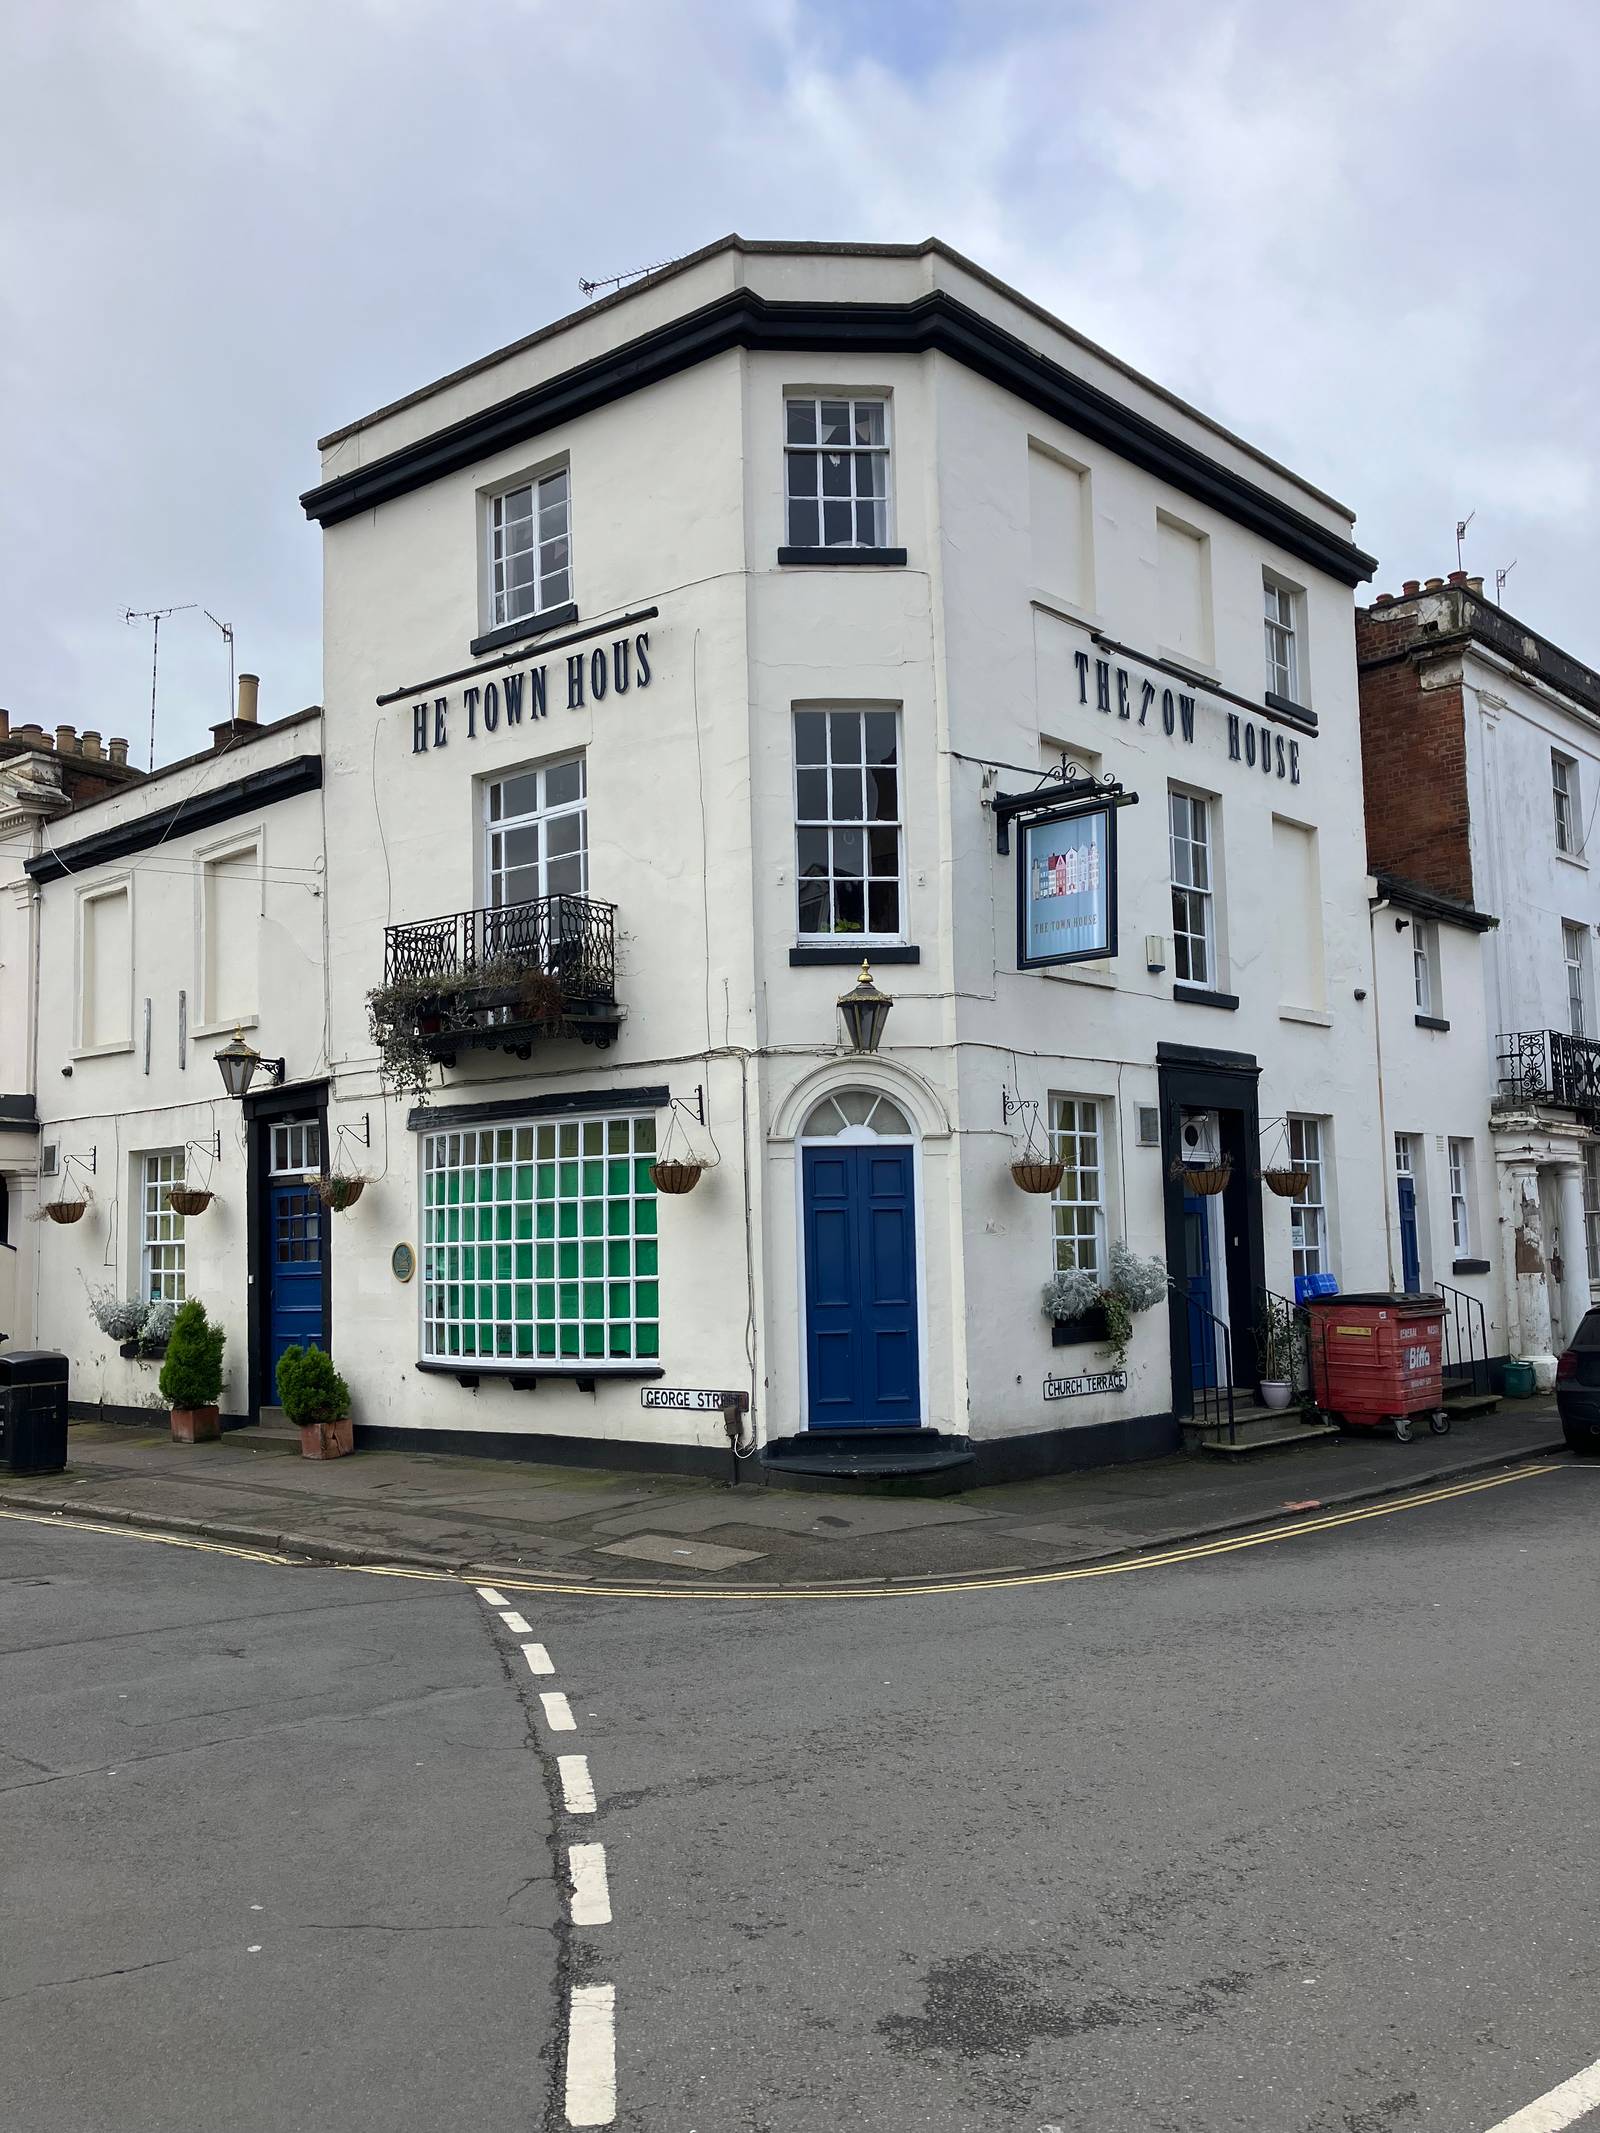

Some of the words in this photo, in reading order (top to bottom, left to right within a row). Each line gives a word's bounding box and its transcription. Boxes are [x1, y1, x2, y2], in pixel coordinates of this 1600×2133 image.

[412, 696, 447, 754] HE
[463, 664, 547, 738] TOWN
[566, 632, 651, 710] HOUS
[1075, 650, 1130, 720] THE
[1138, 679, 1195, 744] TOW
[1228, 712, 1300, 785] HOUSE
[1034, 922, 1049, 934] THE
[1052, 919, 1071, 931] TOWN
[1073, 914, 1097, 928] HOUSE
[1409, 1345, 1430, 1369] Biffa
[1048, 1379, 1083, 1397] CHURCH
[1086, 1373, 1123, 1392] TERRACE
[646, 1390, 690, 1406] GEORGE
